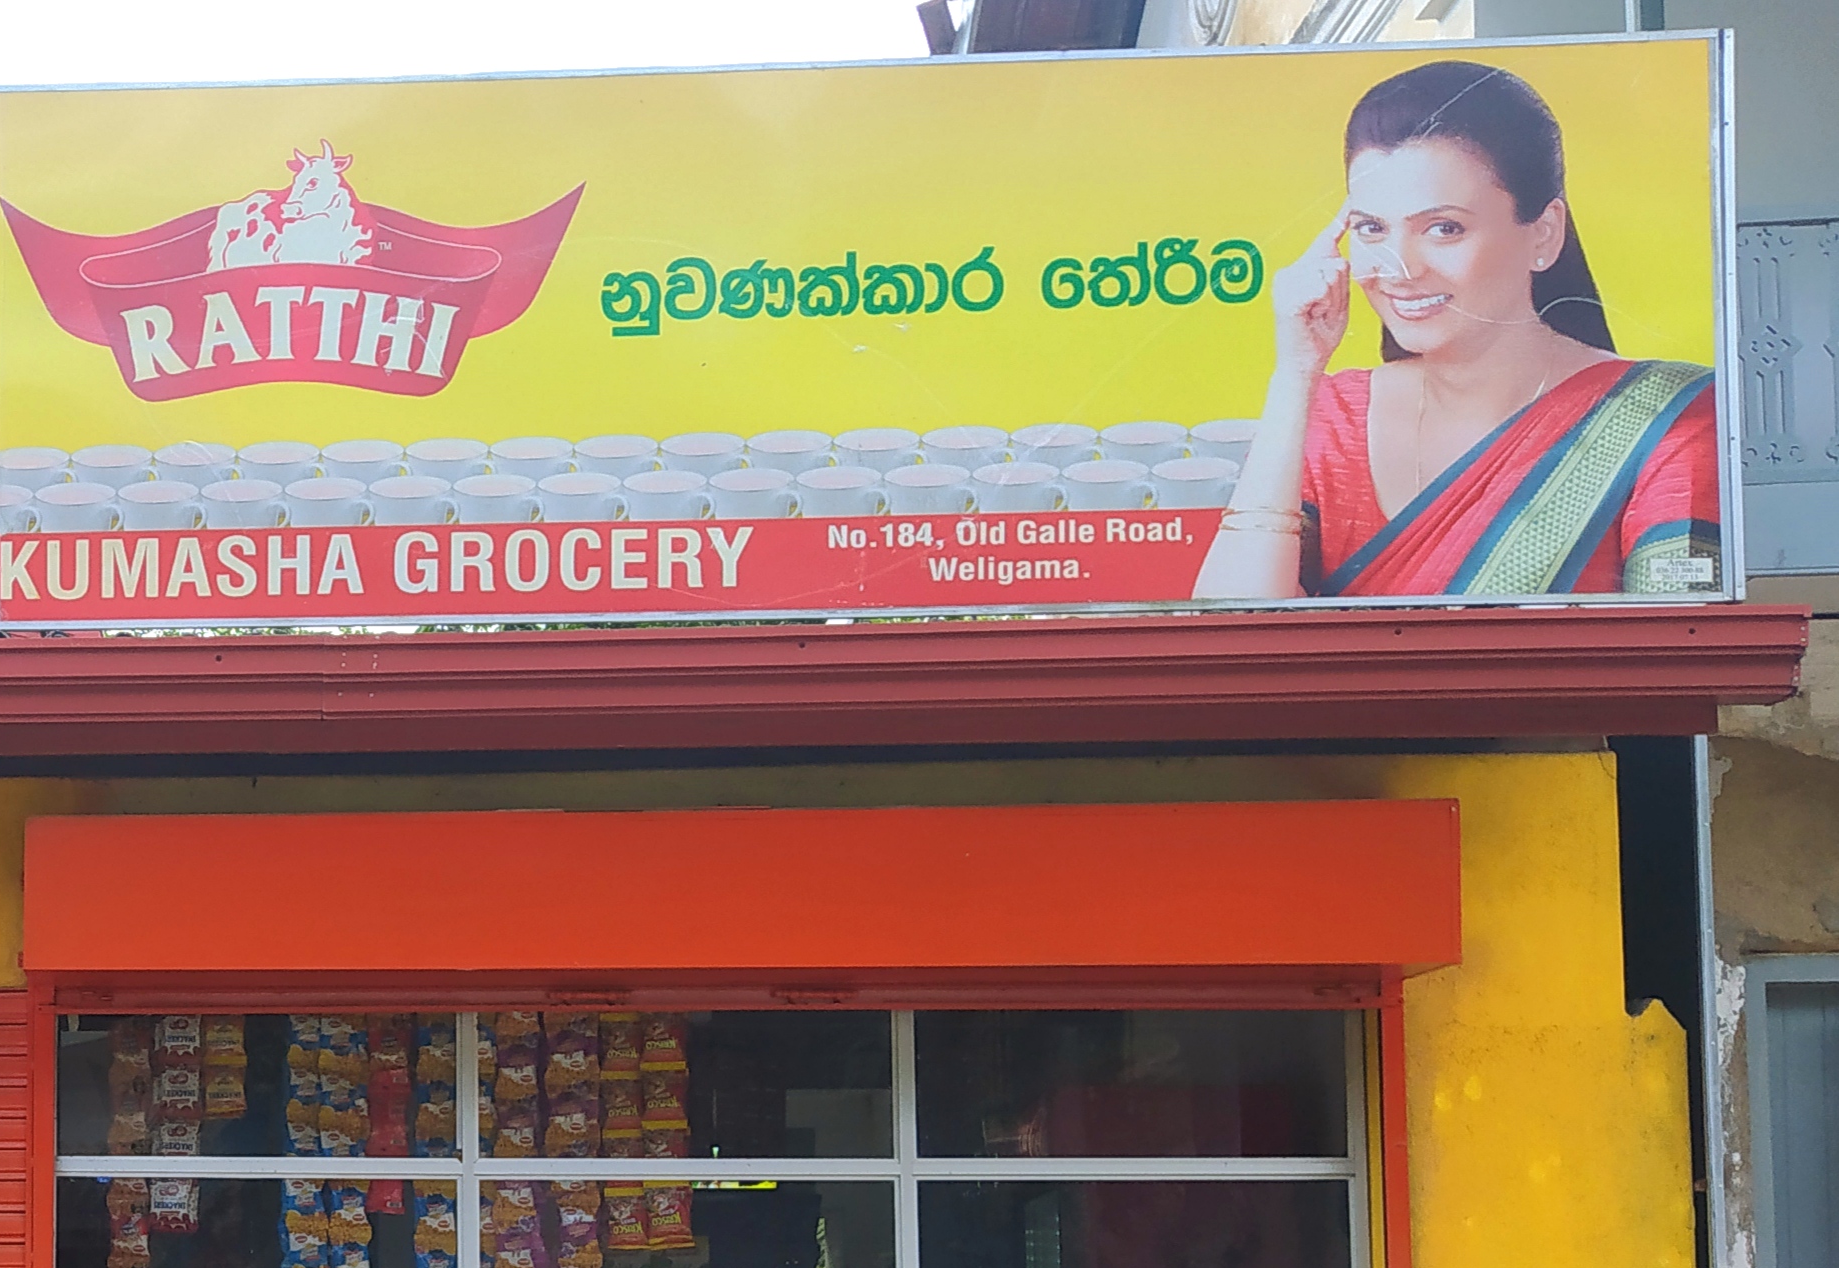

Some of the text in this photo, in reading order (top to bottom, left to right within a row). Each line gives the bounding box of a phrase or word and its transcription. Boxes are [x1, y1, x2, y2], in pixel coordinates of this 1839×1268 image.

[1040, 239, 1265, 309] තේරීම
[119, 284, 461, 382] RATTHI
[827, 515, 1194, 552] No.184, Old Galle Road,
[0, 526, 755, 600] KUMASHA GROCERY
[928, 556, 1091, 588] Weligama.
[646, 1038, 678, 1050] KRISCO
[608, 1104, 639, 1117] KRISCO
[647, 1096, 678, 1109] KRISCO
[613, 1222, 643, 1235] KRISCO
[651, 1213, 682, 1227] KRISCO
